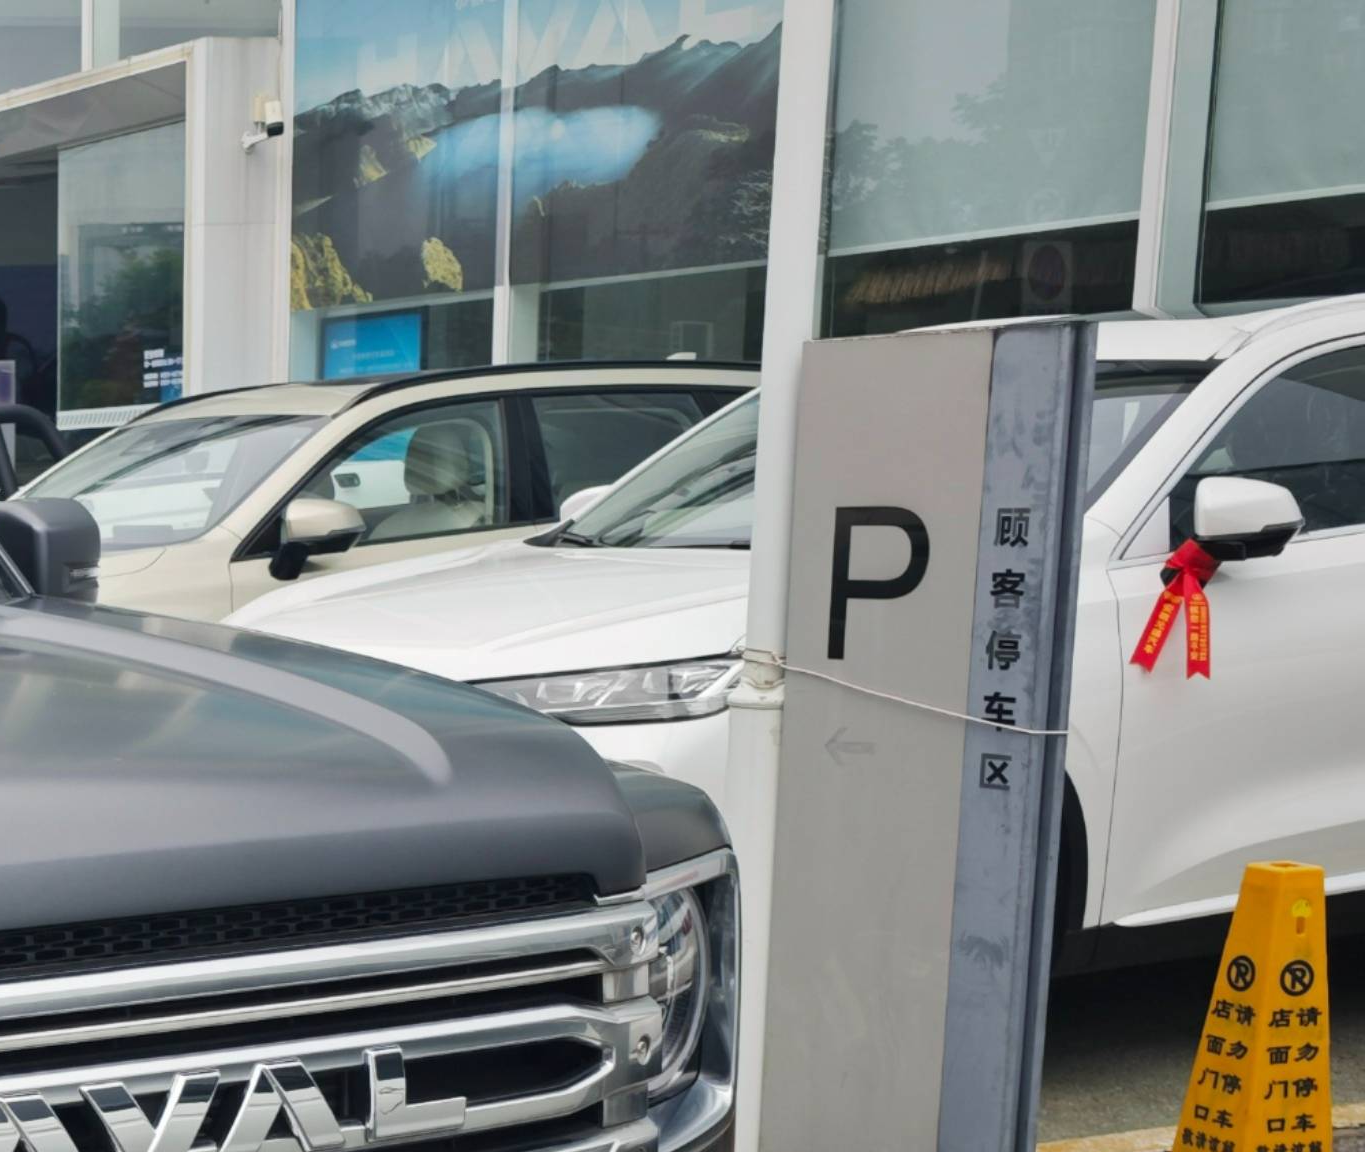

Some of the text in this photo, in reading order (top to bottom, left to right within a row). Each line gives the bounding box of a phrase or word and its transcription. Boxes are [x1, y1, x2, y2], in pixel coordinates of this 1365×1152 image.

[827, 506, 930, 660] P
[979, 507, 1032, 791] 顾客停车区
